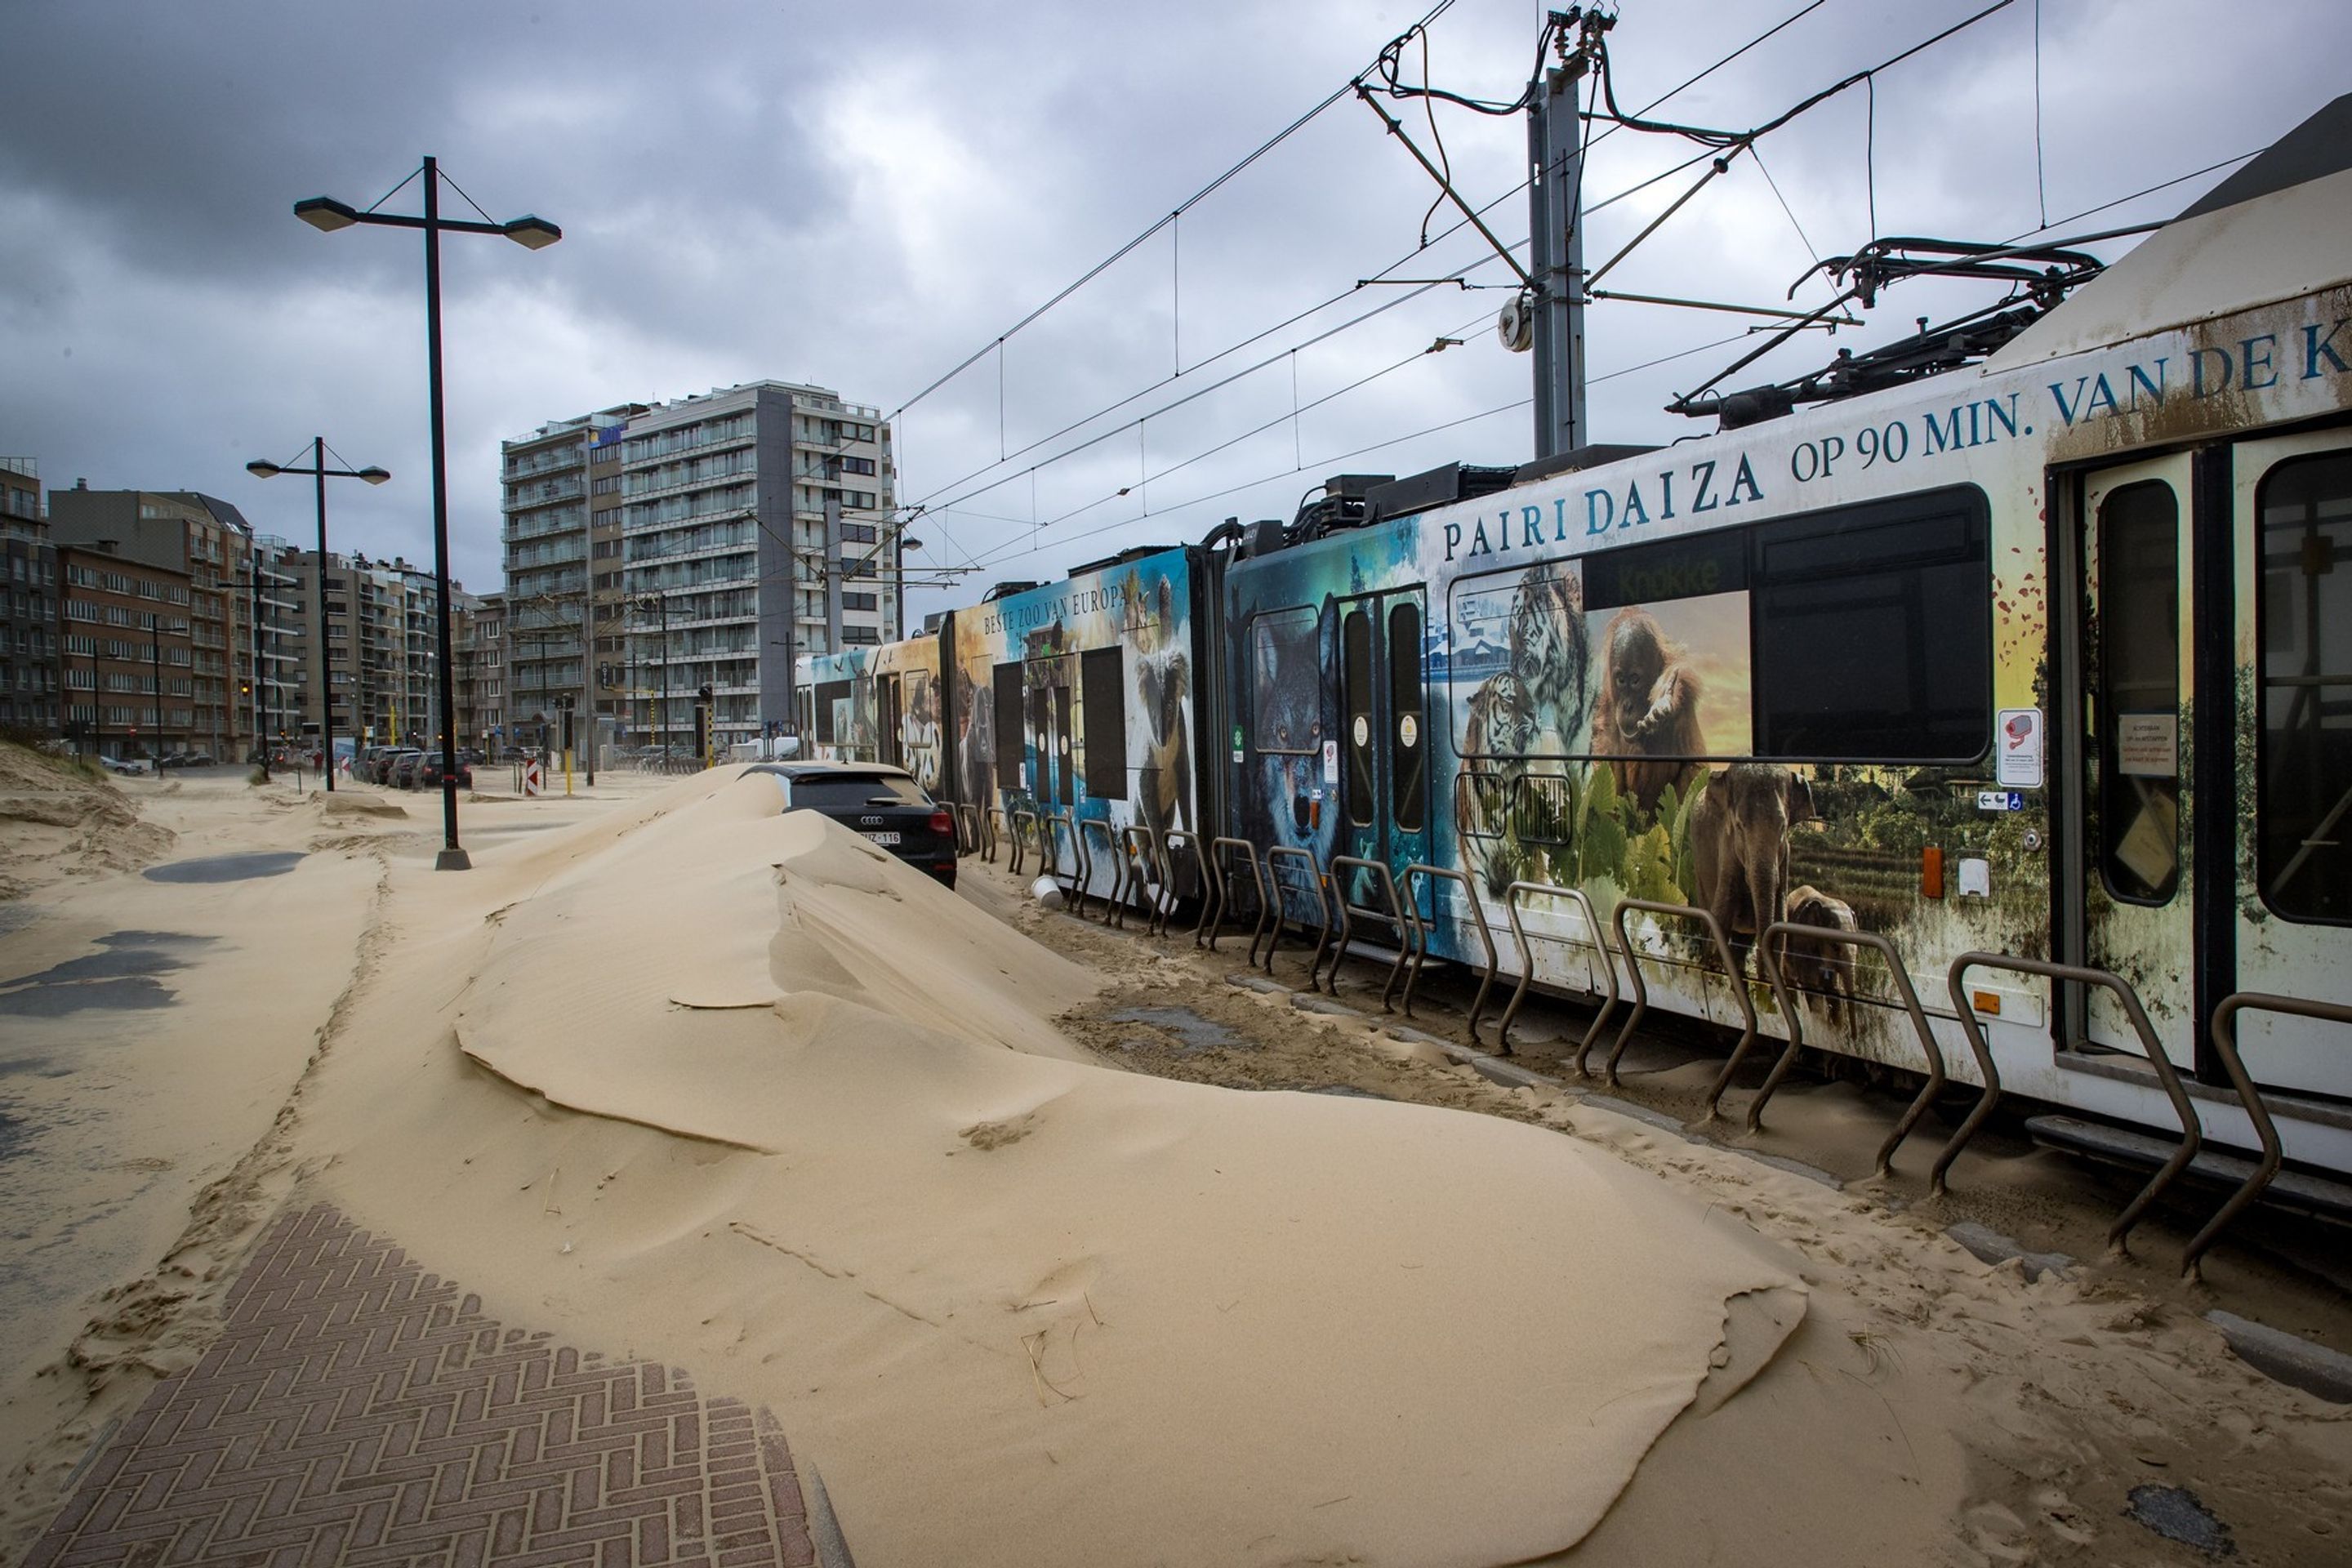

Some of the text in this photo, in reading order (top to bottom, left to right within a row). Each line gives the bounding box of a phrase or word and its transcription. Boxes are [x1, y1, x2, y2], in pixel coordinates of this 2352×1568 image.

[1443, 498, 1566, 562] PAIRI
[1584, 450, 1765, 536] DAIZA
[1791, 436, 1845, 482] OP
[1856, 421, 1909, 470] 90
[1922, 392, 2034, 457] MIN.
[2047, 358, 2170, 428] VAN
[2187, 333, 2280, 401] DE
[984, 585, 1130, 635] BESTE ZOO VAN EUROPA
